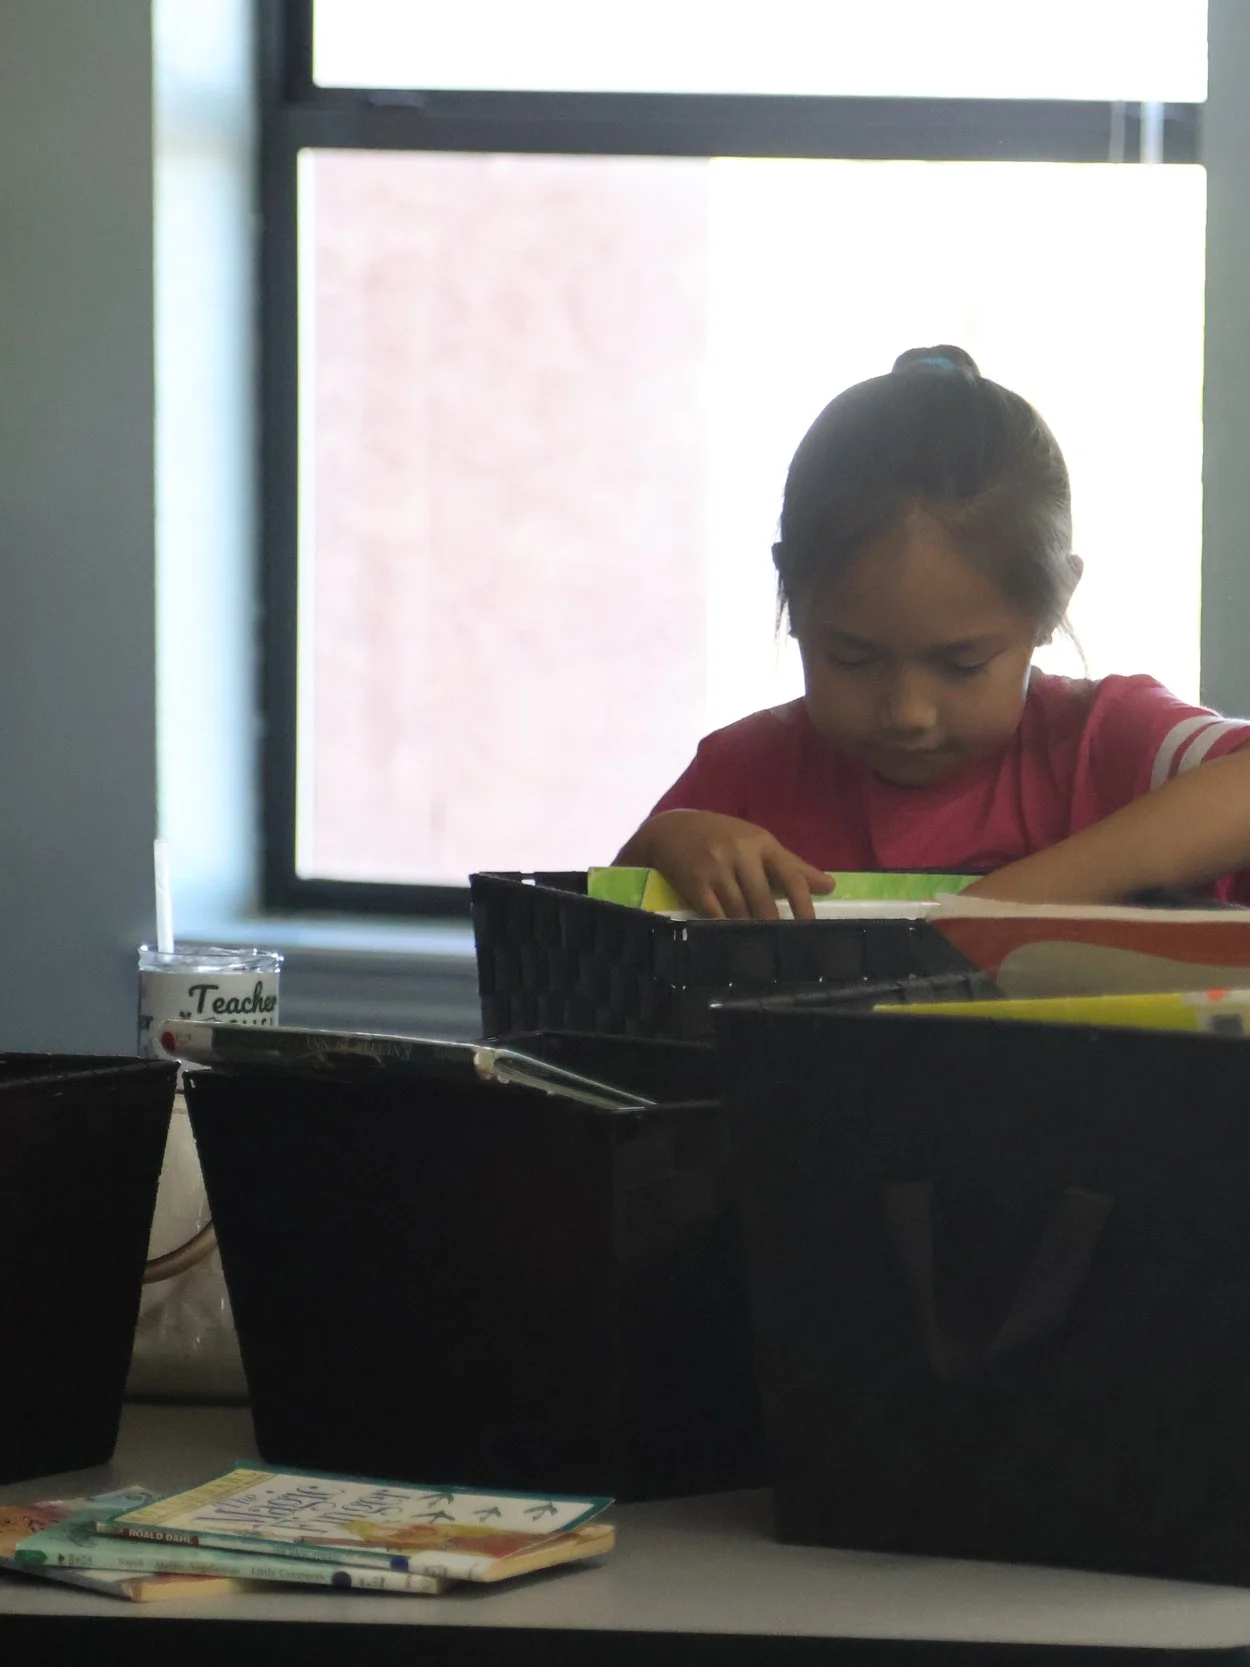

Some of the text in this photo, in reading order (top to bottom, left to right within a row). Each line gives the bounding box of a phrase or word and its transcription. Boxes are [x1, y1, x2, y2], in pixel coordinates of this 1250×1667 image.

[193, 1486, 345, 1528] Magic
[270, 1489, 411, 1532] Finger
[128, 1528, 191, 1544] ROALD DAHL
